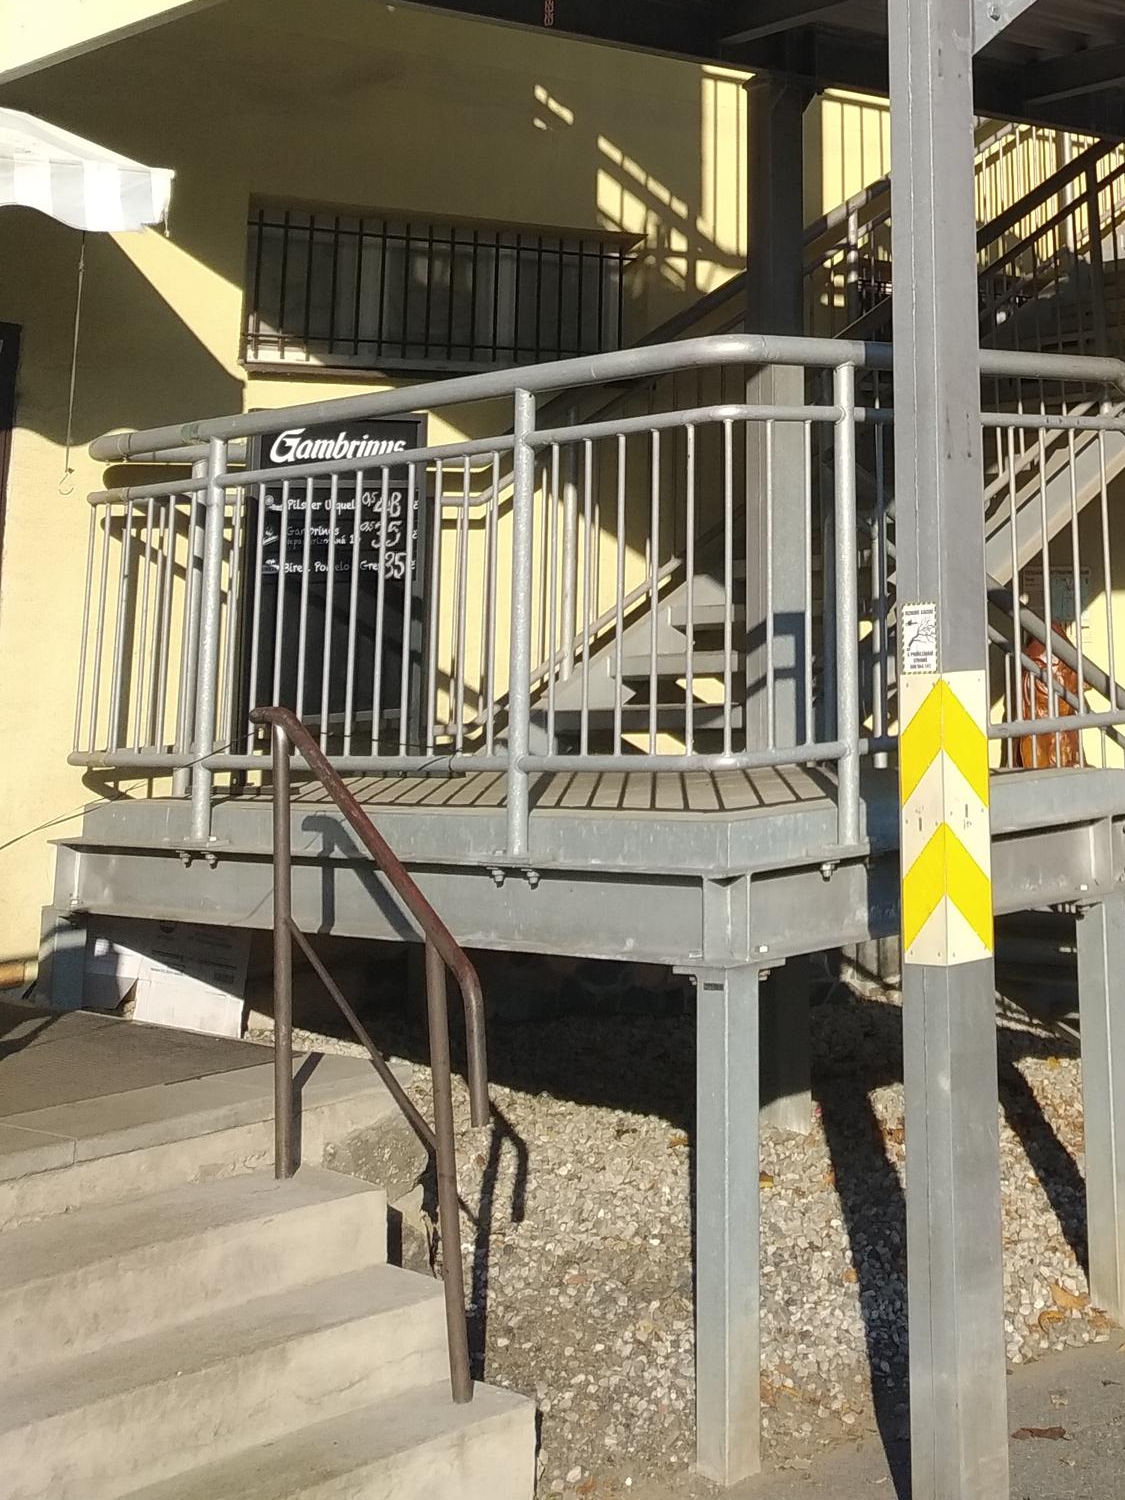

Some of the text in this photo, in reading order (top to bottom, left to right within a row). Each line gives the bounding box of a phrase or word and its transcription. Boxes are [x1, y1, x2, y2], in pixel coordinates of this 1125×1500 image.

[269, 427, 407, 464] Gambrinus
[287, 498, 322, 510] Pilser
[384, 551, 407, 580] 35
